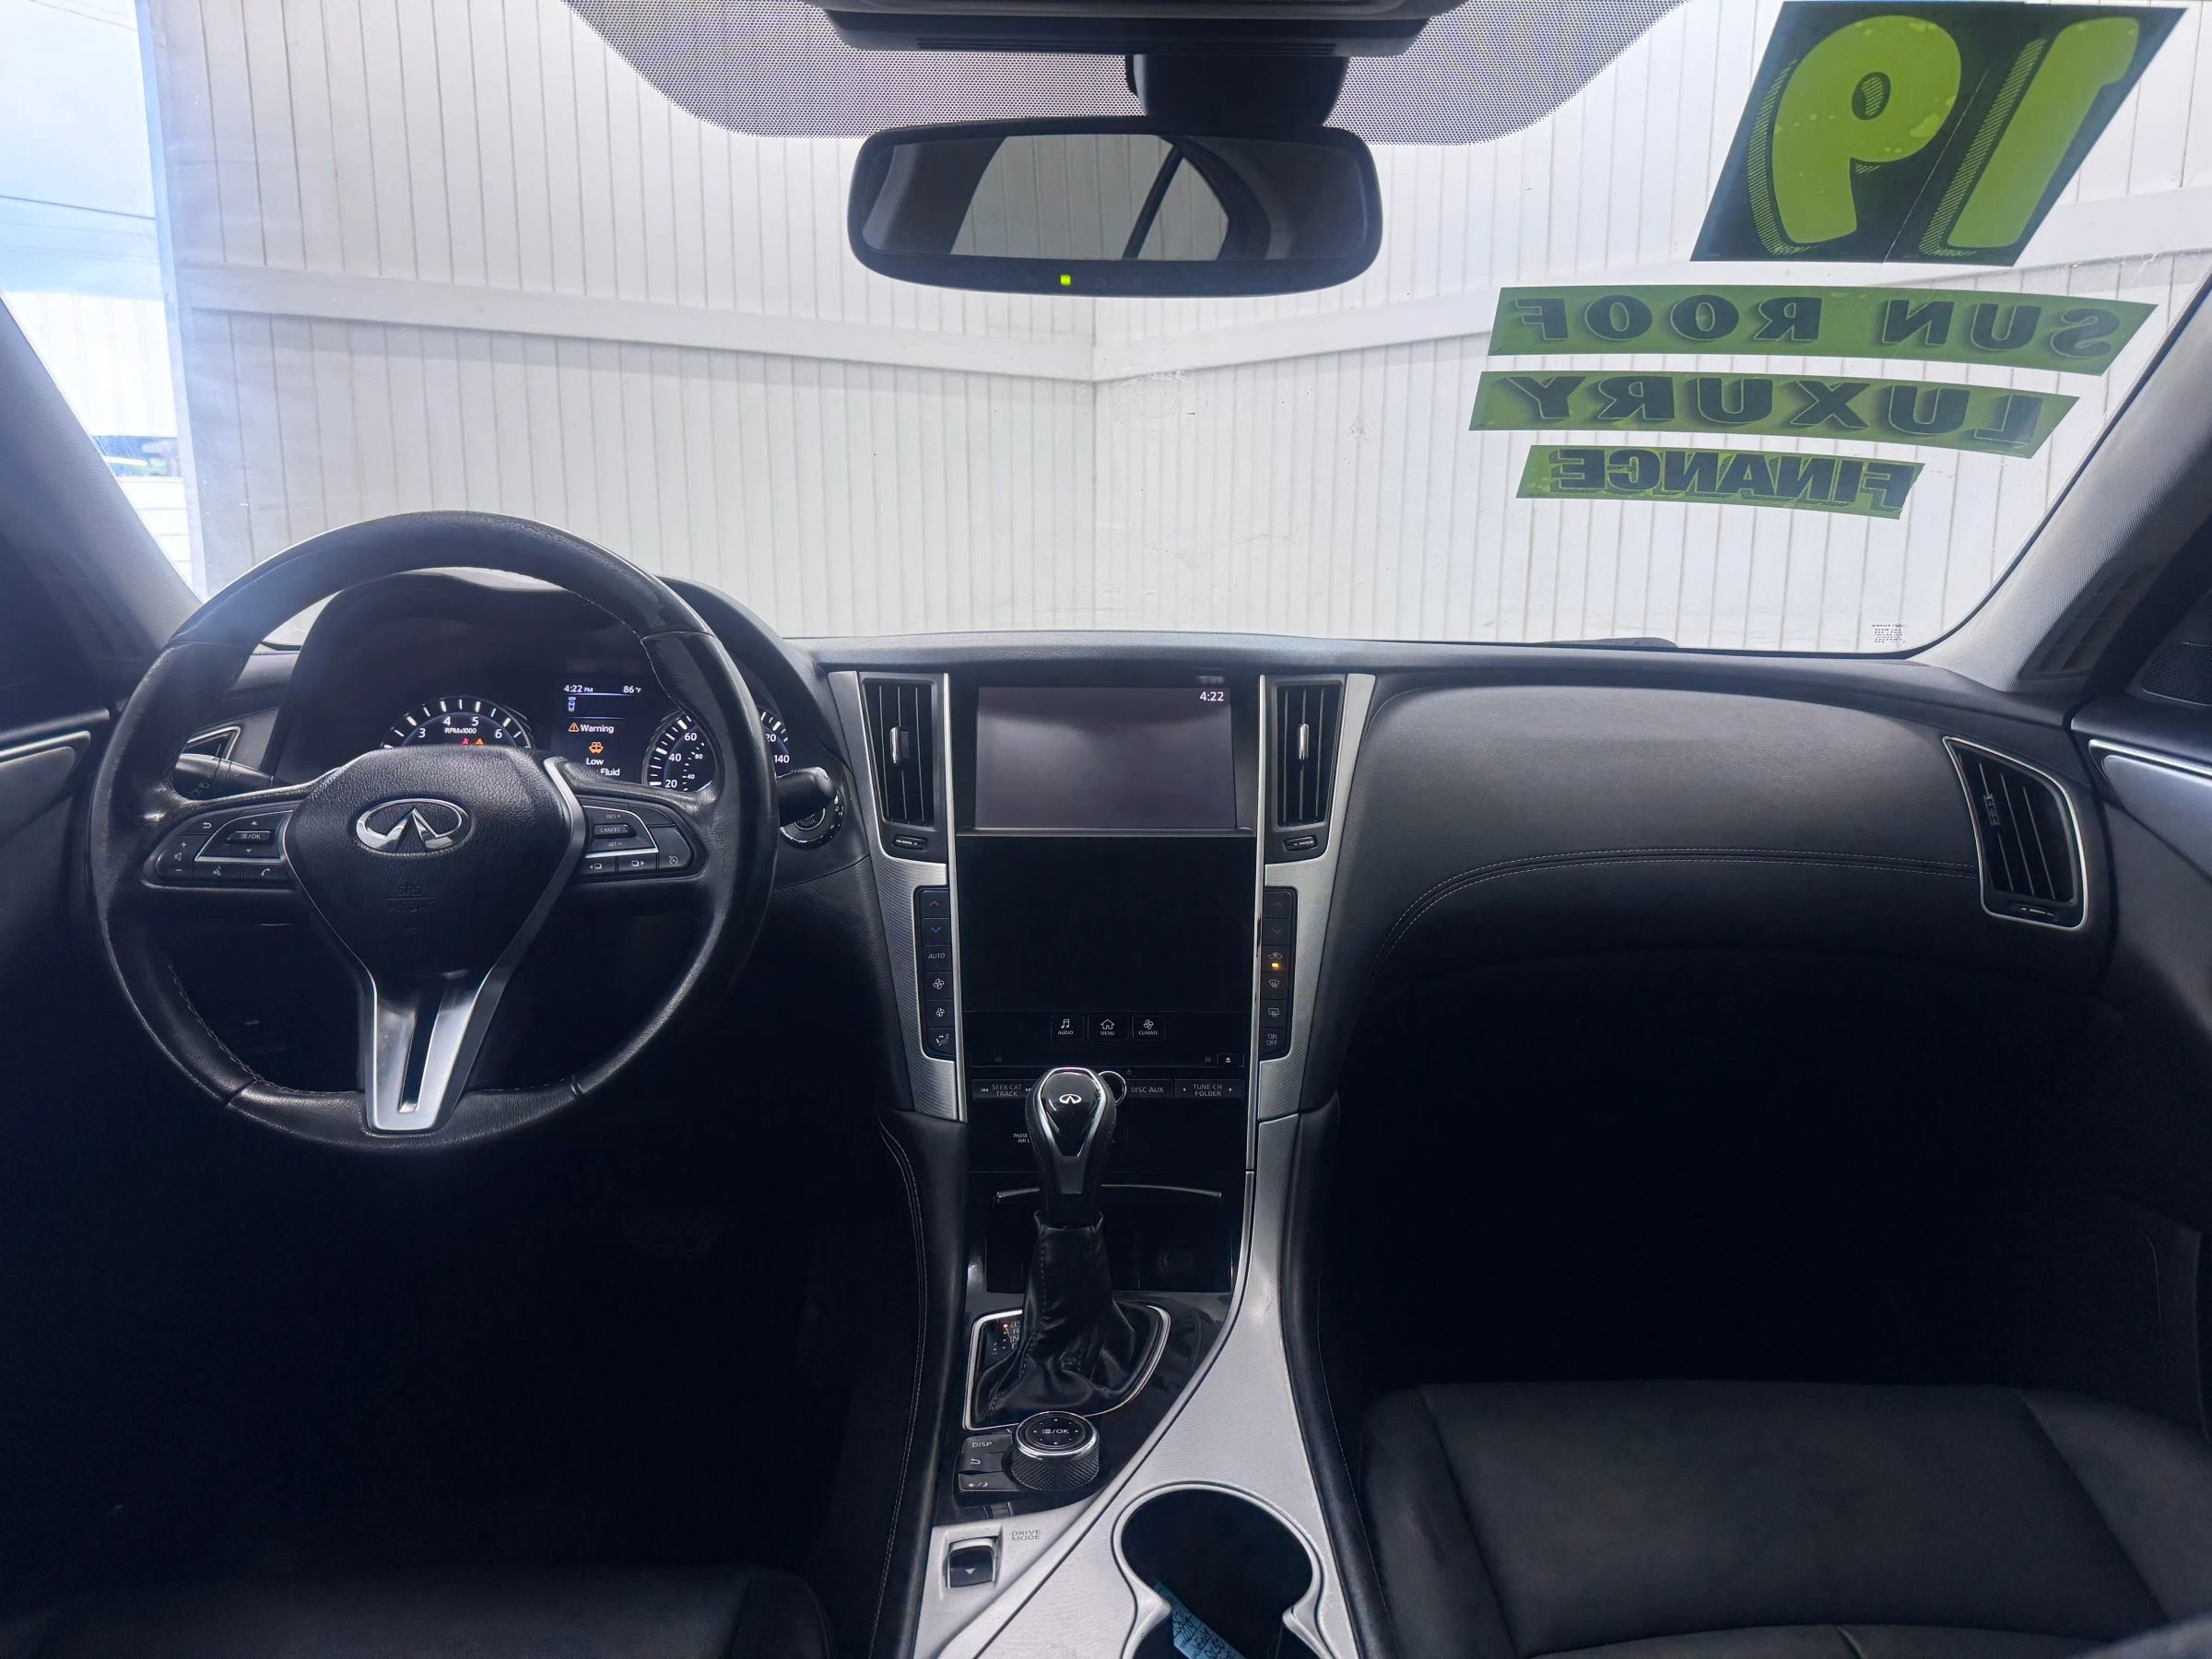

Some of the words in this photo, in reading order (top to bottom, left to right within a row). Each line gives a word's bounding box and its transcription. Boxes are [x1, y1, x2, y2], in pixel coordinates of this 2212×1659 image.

[563, 685, 582, 693] 4:22
[1199, 690, 1225, 701] 4:22
[443, 716, 451, 725] 4
[472, 716, 479, 726] 5
[418, 728, 426, 737] 3
[495, 728, 502, 738] 6
[581, 724, 615, 735] Warning
[684, 733, 697, 741] 60
[586, 758, 605, 766] Low
[668, 753, 682, 762] 40
[774, 754, 790, 764] 140
[600, 768, 620, 776] Fluid
[665, 780, 677, 788] 20
